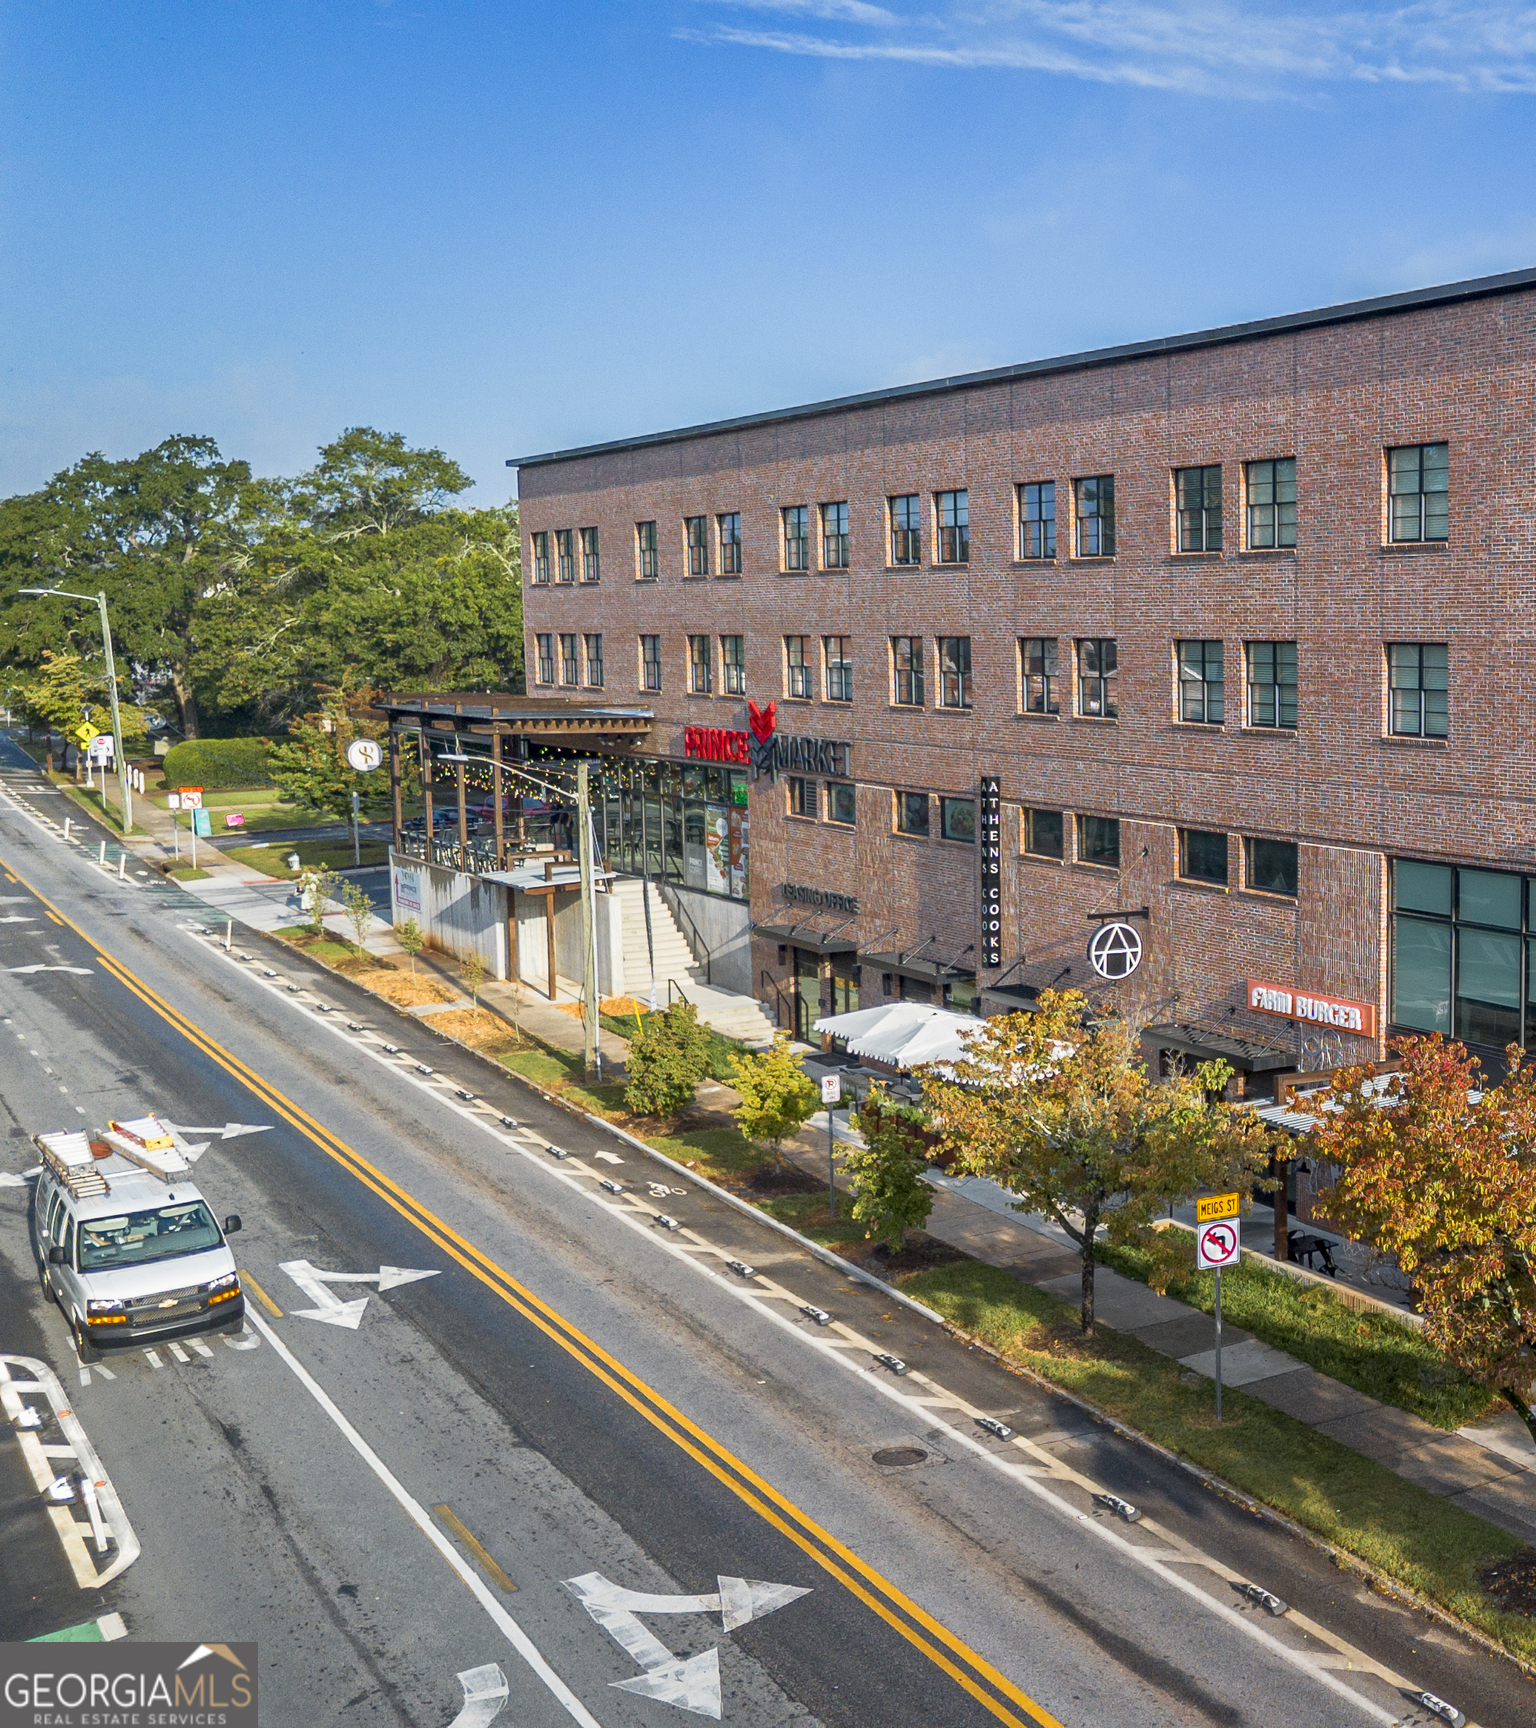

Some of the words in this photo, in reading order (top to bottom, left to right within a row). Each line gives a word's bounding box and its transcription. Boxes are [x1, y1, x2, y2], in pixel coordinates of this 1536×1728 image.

[684, 726, 750, 765] PRINCE
[774, 733, 853, 776] MARKET
[989, 781, 999, 873] ATHENS
[989, 888, 1000, 963] COOKS
[1252, 987, 1292, 1014] FARM
[1296, 996, 1362, 1031] BURGER
[1201, 1201, 1224, 1216] MEIGS
[1227, 1199, 1236, 1212] ST
